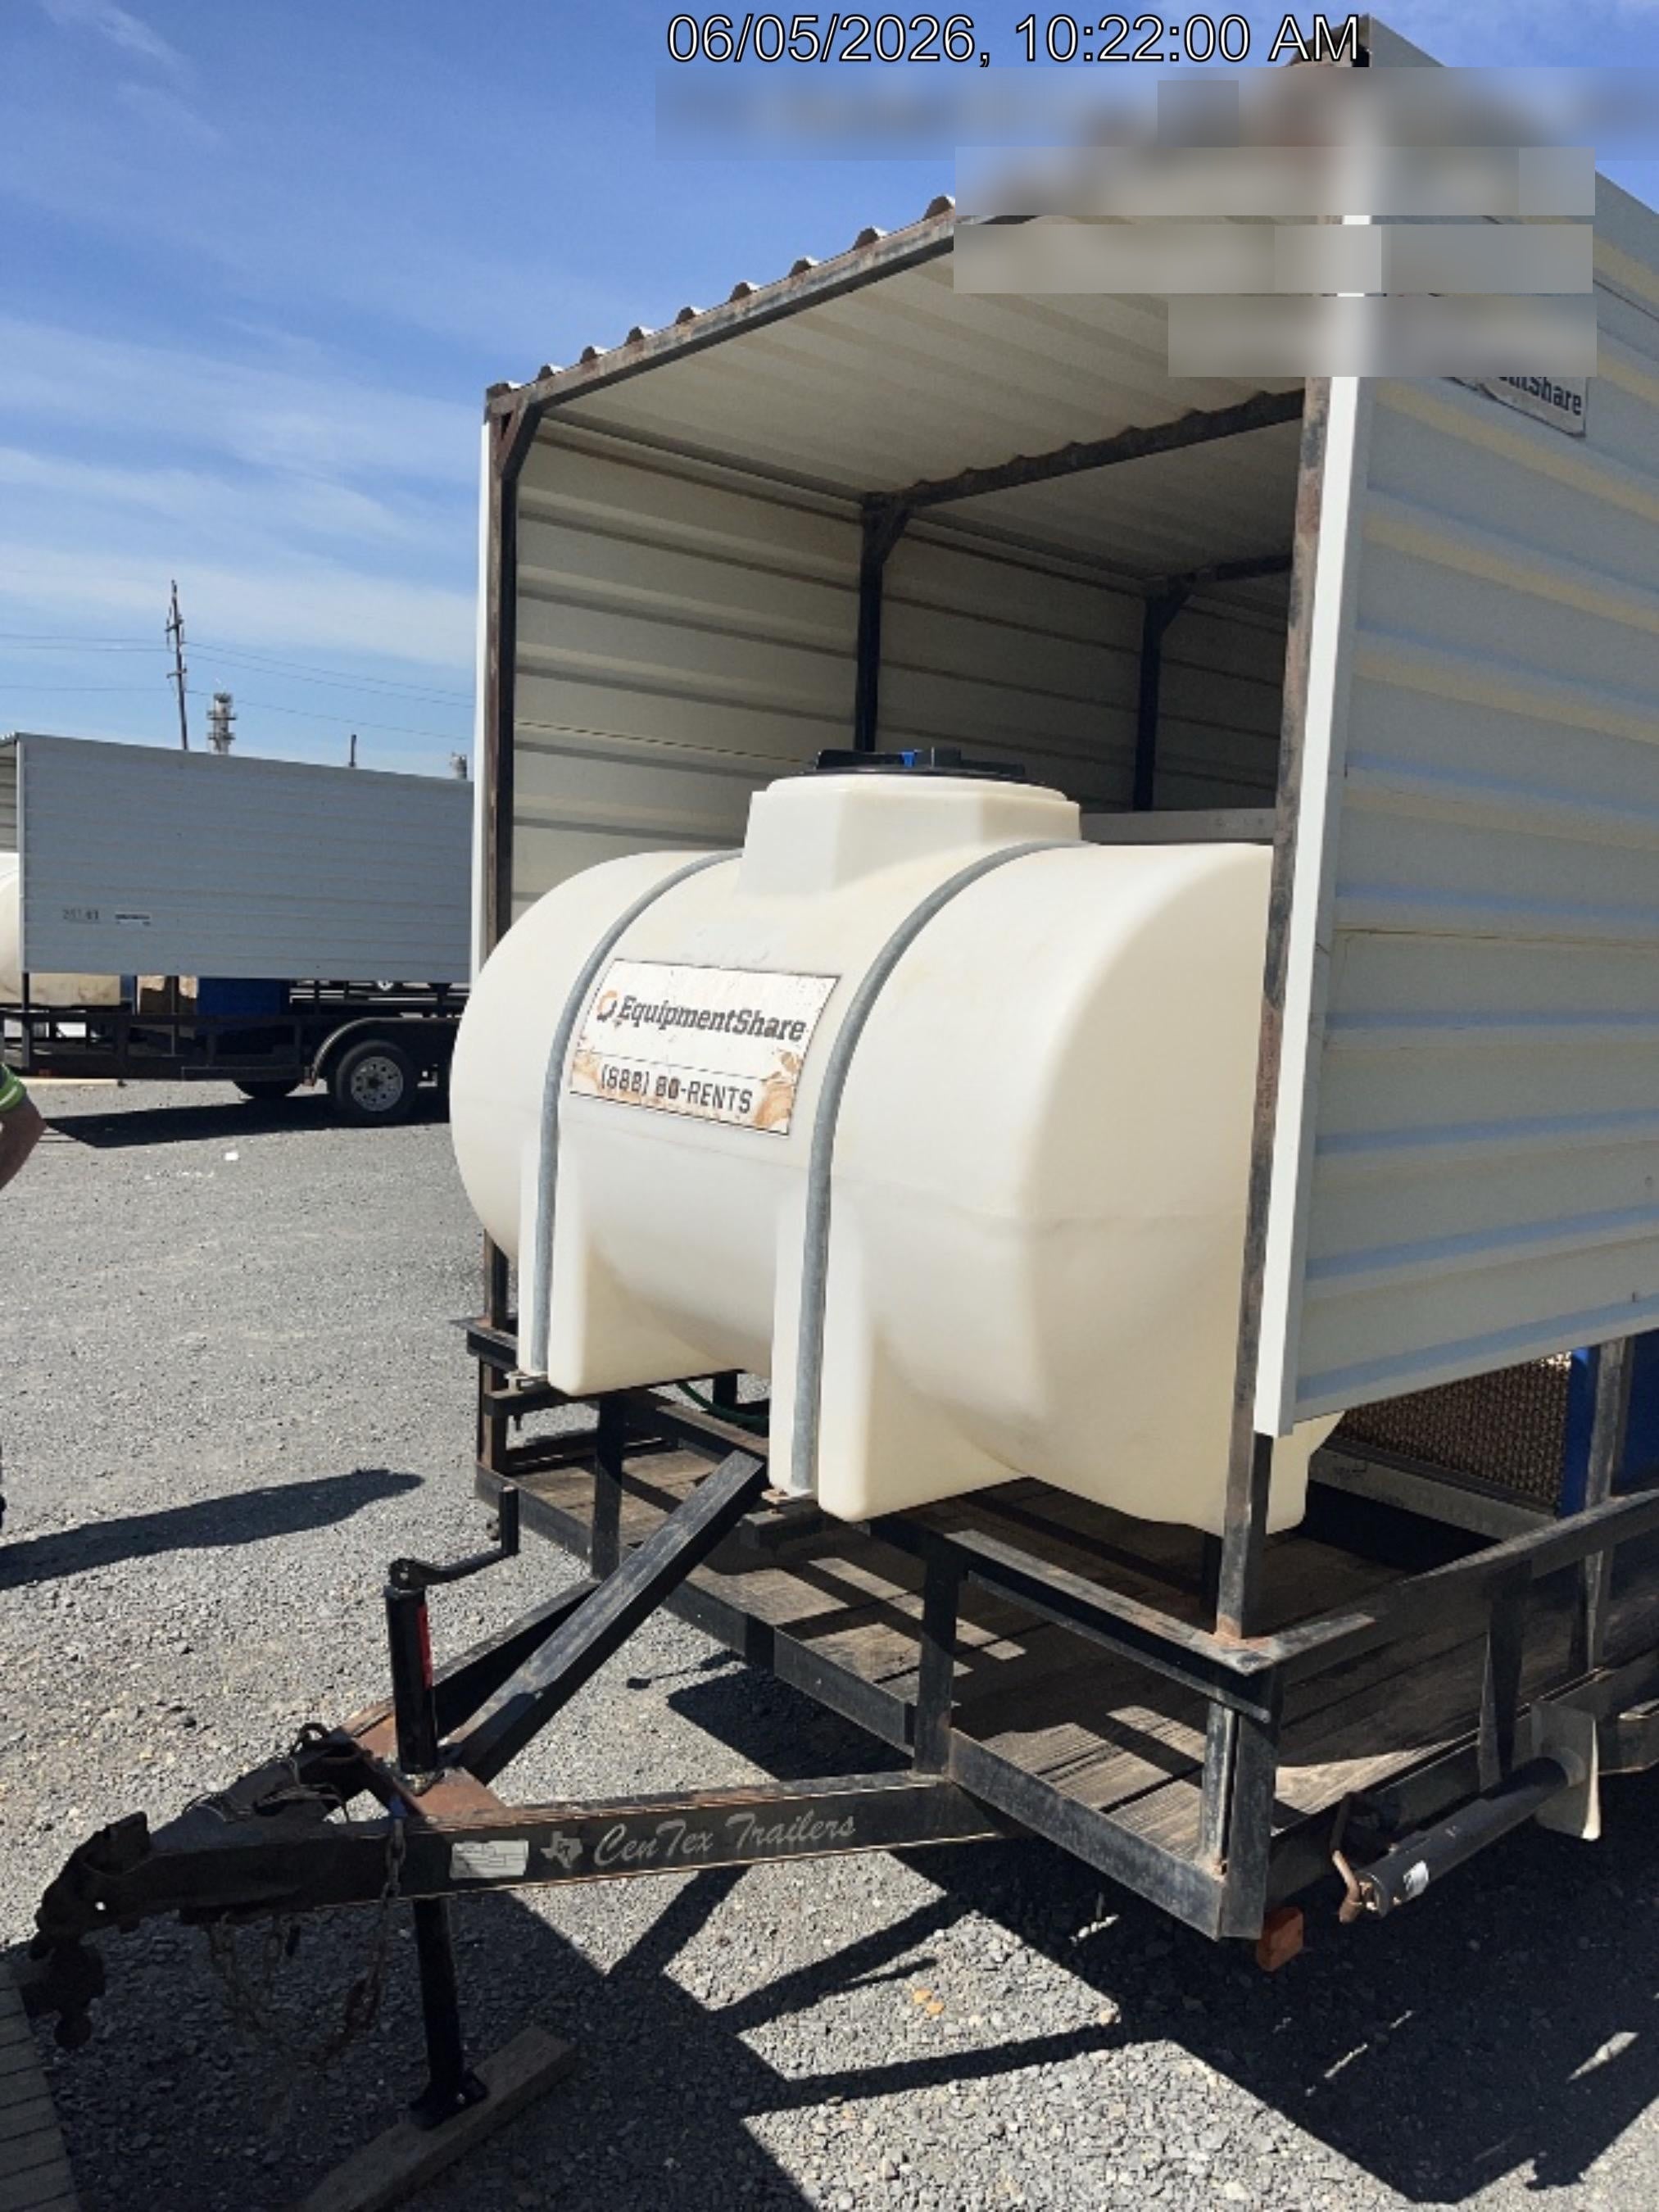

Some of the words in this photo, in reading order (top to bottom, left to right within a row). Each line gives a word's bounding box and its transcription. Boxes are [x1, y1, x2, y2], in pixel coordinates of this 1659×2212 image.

[617, 995, 806, 1041] EquipmentShare
[594, 1819, 714, 1866] CenTex
[725, 1809, 856, 1849] Trailers
